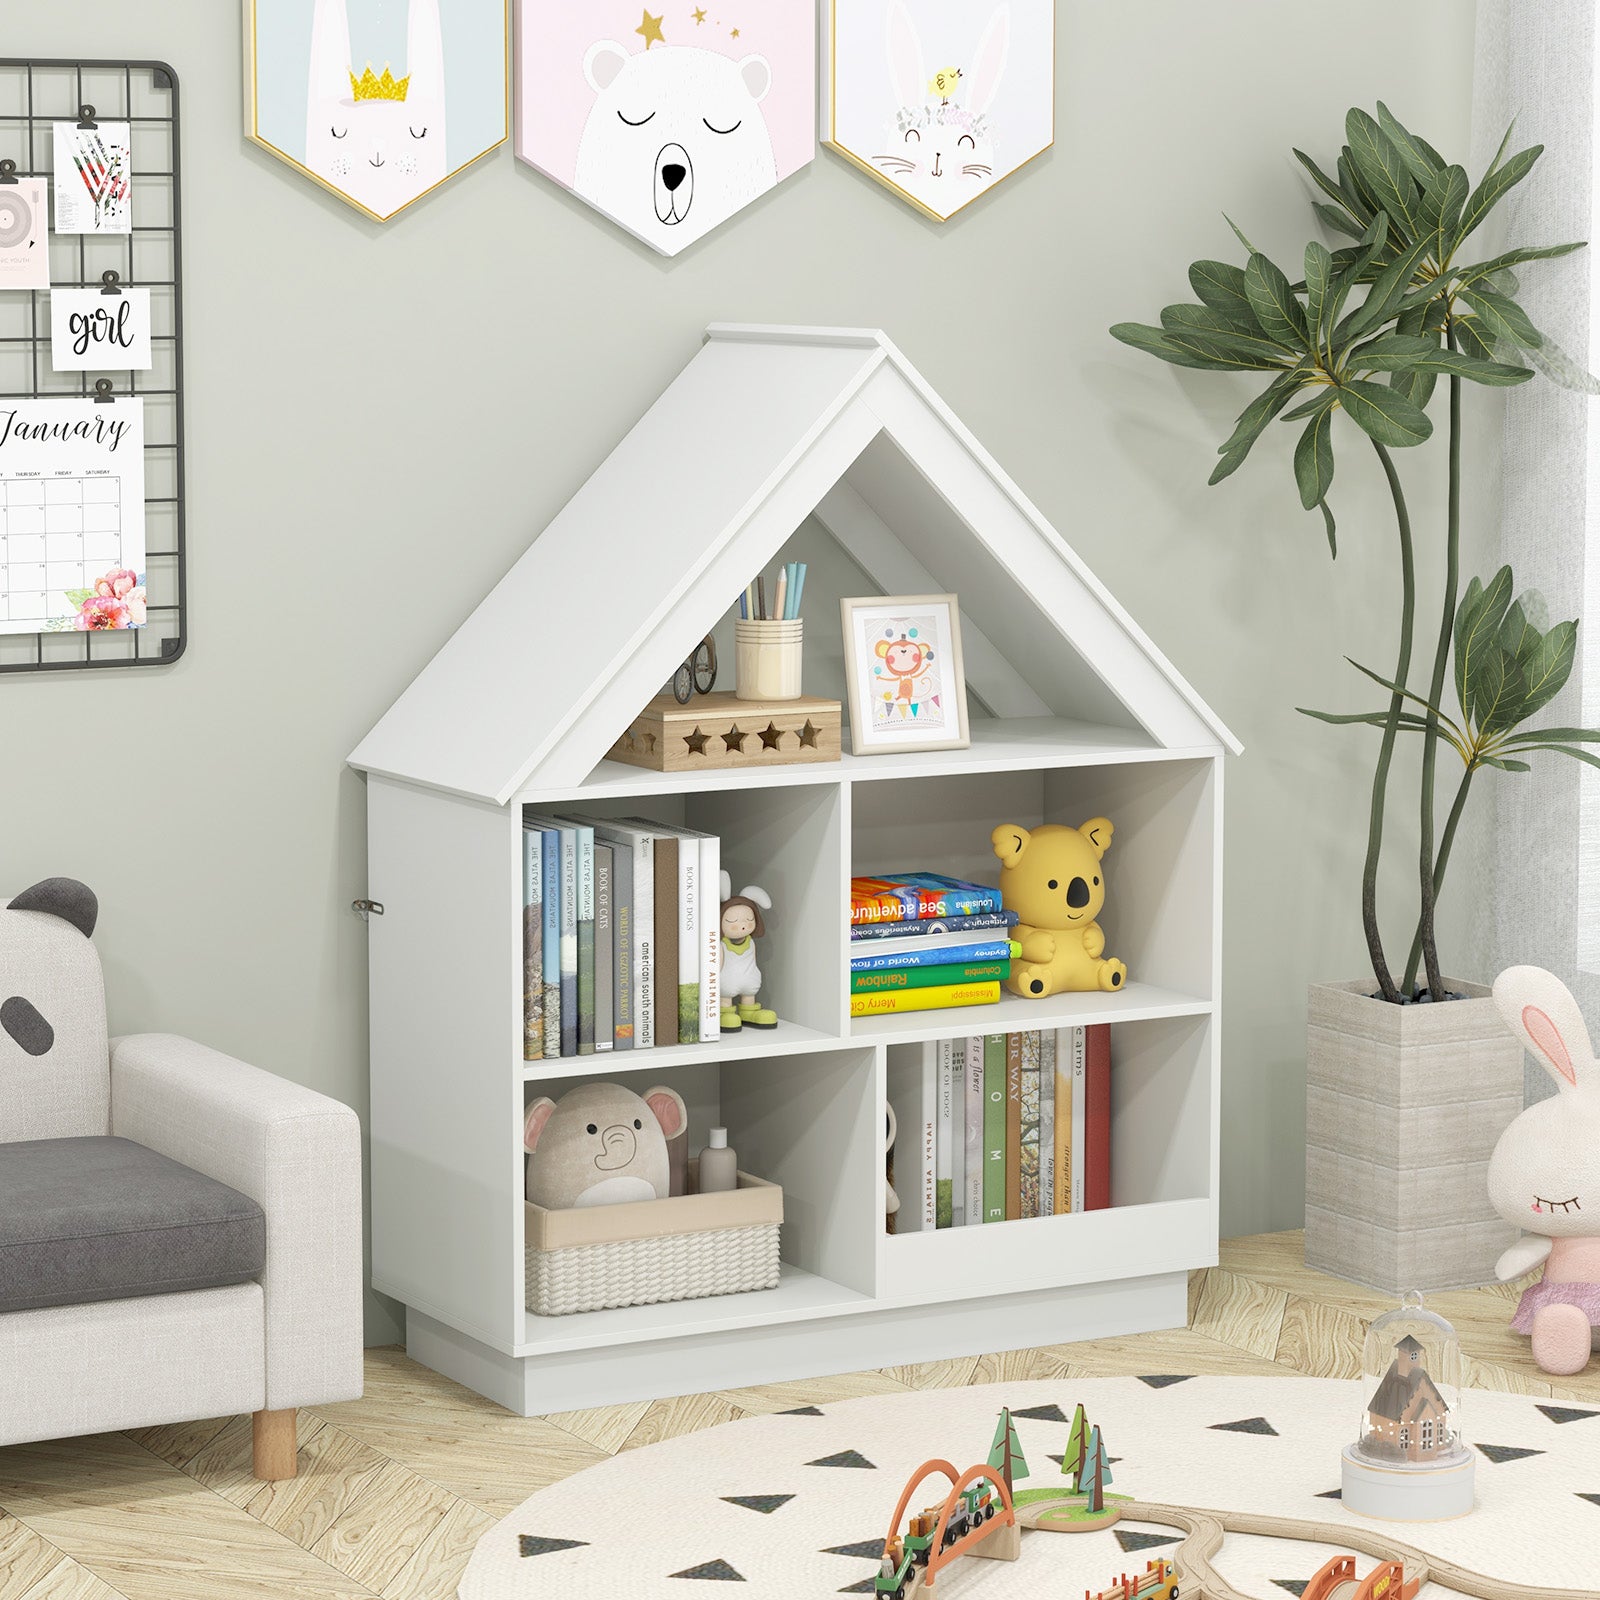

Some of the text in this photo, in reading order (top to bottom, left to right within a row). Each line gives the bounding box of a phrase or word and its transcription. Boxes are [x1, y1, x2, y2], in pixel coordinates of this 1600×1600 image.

[69, 300, 135, 356] girl
[0, 410, 131, 452] January
[599, 867, 608, 929] BOOK OF CATS
[686, 867, 694, 931] BOOK OF DOGS
[955, 899, 993, 908] Louisiana
[919, 901, 946, 915] Sea
[620, 906, 628, 936] WORLD
[875, 925, 920, 935] Mysterious
[620, 939, 628, 949] OF
[974, 949, 1007, 957] Sydney
[873, 959, 885, 968] of
[888, 957, 920, 965] World
[964, 966, 1001, 976] Columbia
[855, 973, 907, 987] Rainbow
[642, 942, 651, 1044] american south animals
[951, 989, 993, 999] Mississippi
[621, 989, 629, 1019] PARROT
[851, 998, 896, 1012] Merry Cit
[973, 1045, 981, 1053] is
[969, 1064, 983, 1094] flower
[1010, 1066, 1019, 1102] WAY
[1048, 1179, 1054, 1188] in
